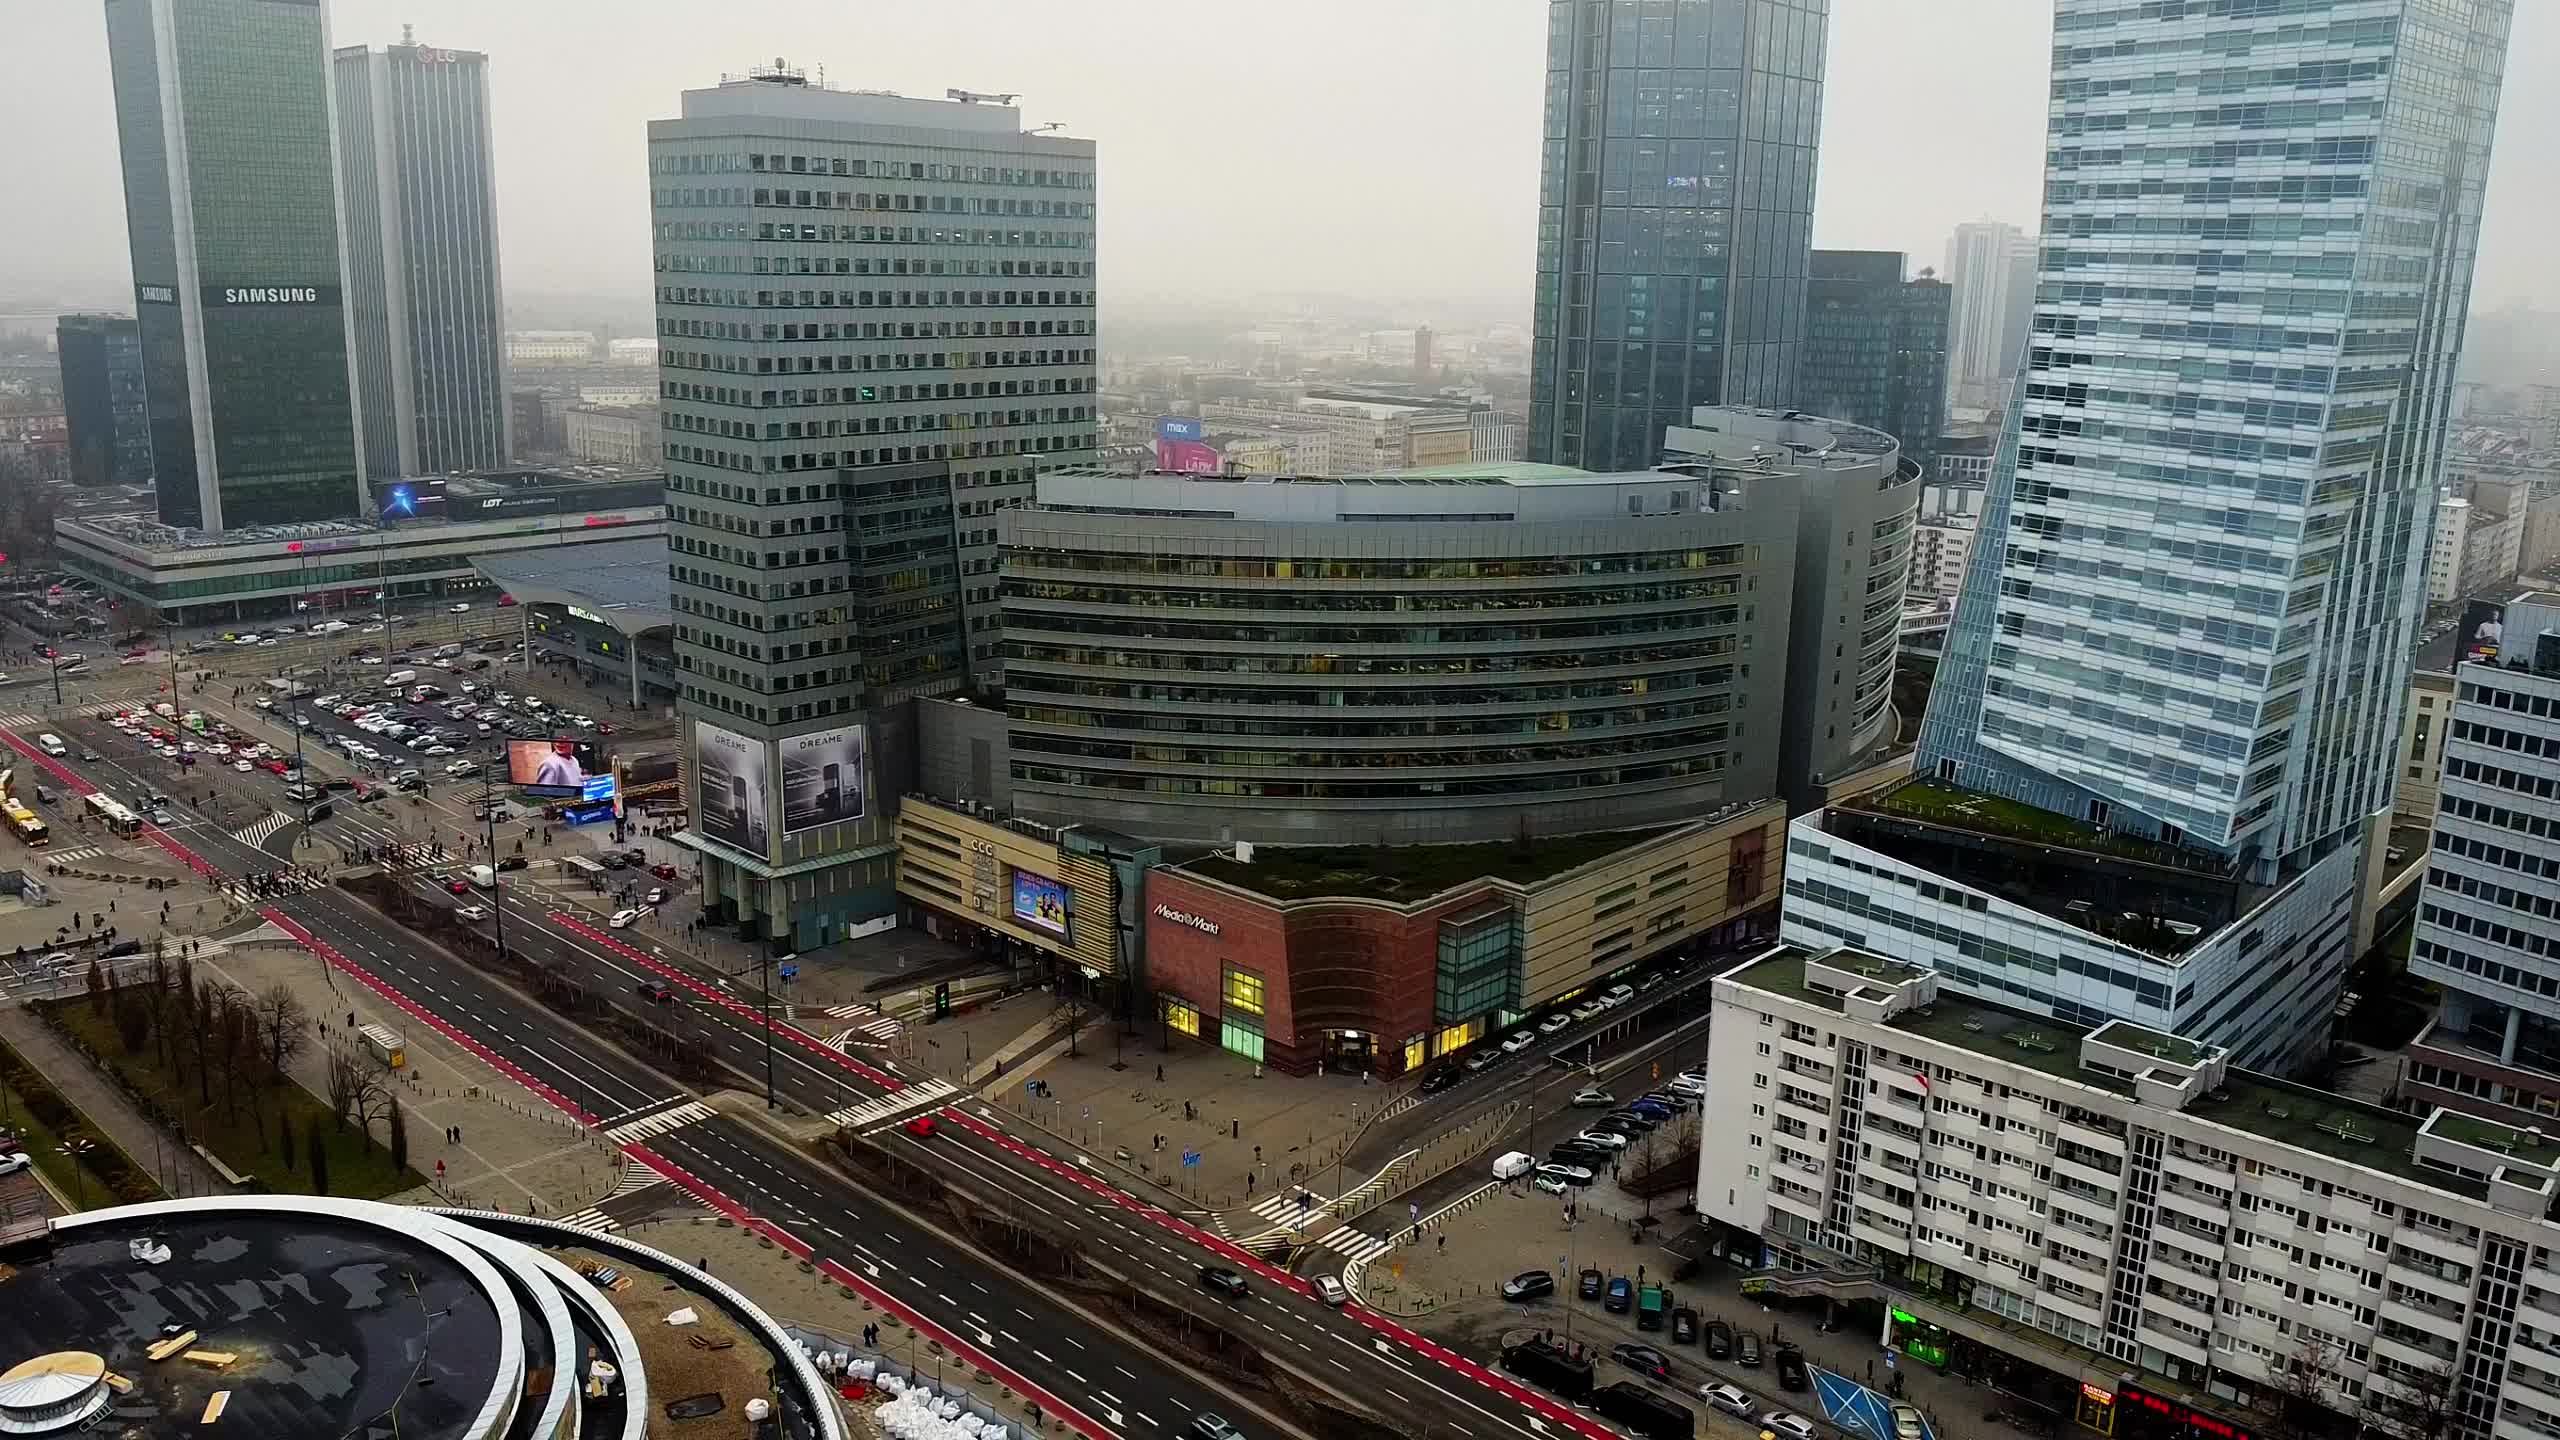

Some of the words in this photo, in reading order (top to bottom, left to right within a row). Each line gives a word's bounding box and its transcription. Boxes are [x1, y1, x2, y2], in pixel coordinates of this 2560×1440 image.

[225, 287, 316, 303] SAMSUNG
[1166, 423, 1188, 433] max
[482, 498, 504, 508] LOT
[714, 735, 748, 753] DREAME
[799, 734, 843, 750] DREAME
[971, 839, 993, 856] CCC
[1153, 903, 1184, 923] Media
[1190, 916, 1219, 935] Markt
